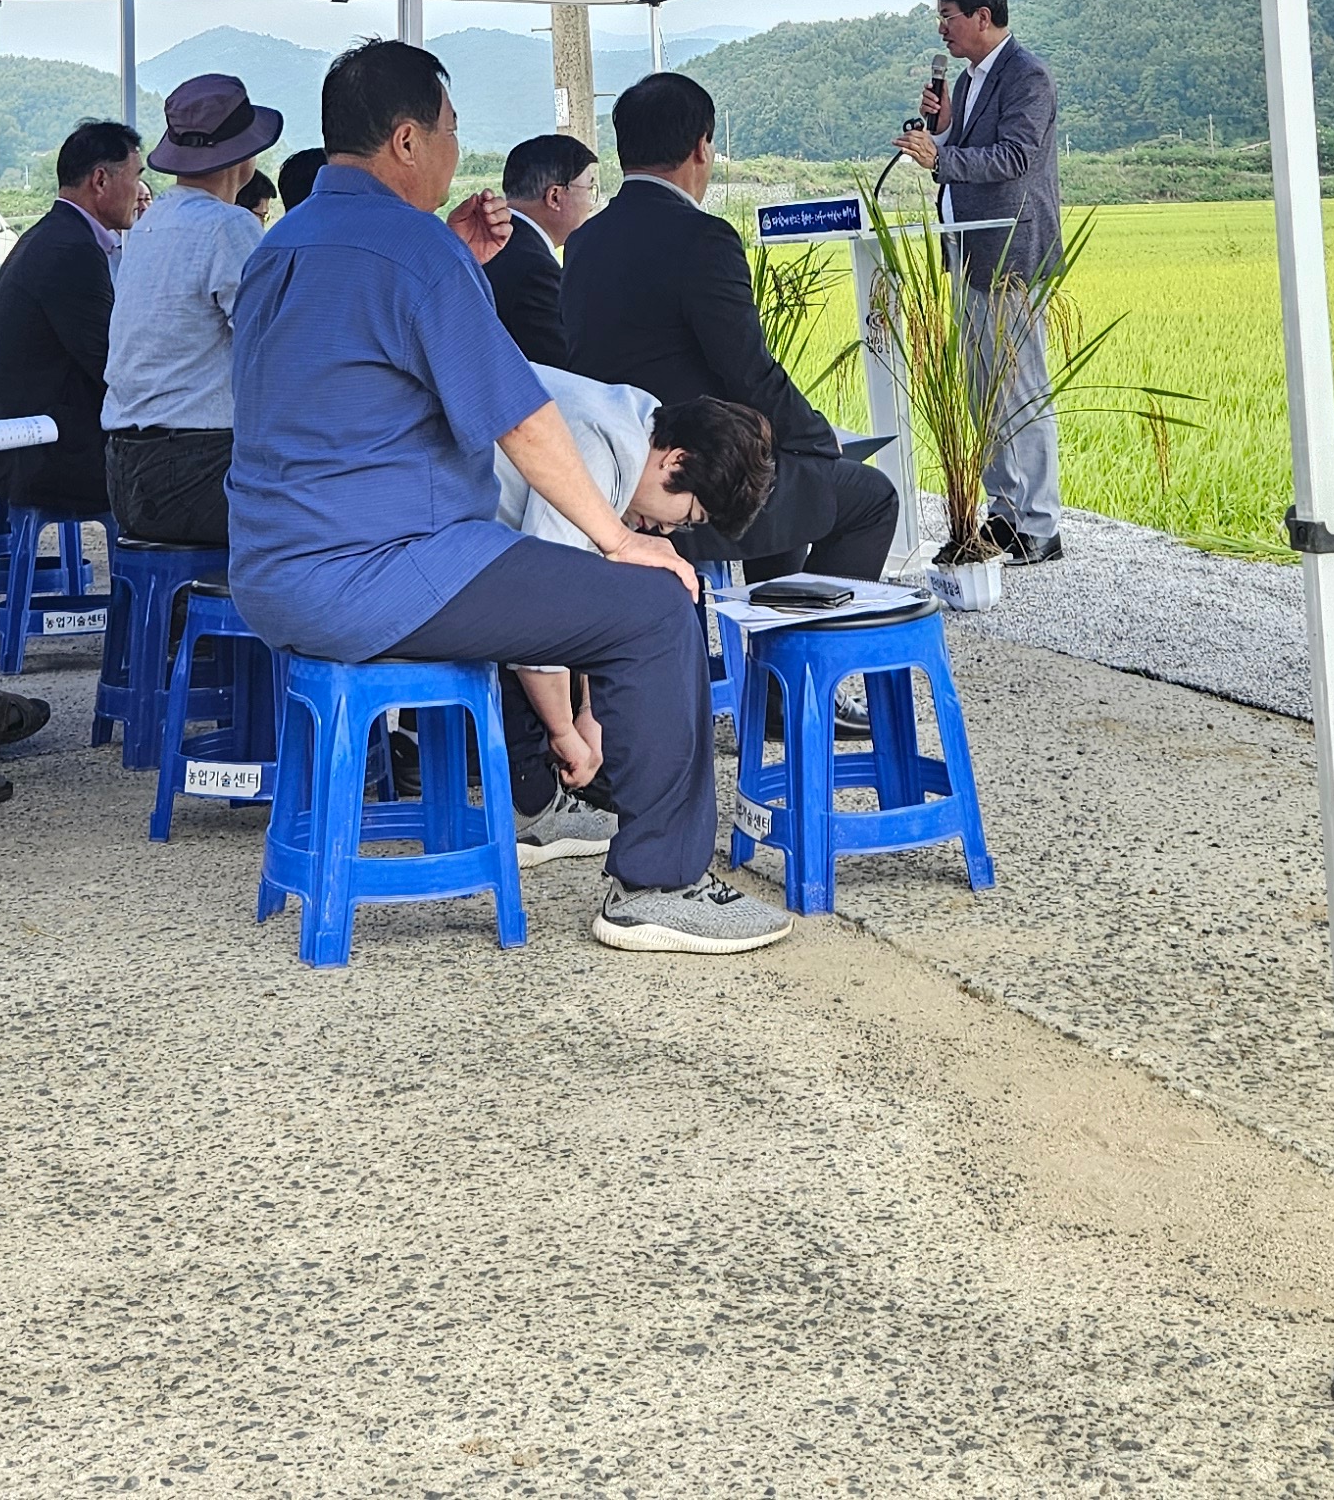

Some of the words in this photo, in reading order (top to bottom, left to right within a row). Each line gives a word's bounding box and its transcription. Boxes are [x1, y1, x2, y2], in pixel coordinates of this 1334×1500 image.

[45, 614, 106, 629] 농업기술센터
[188, 768, 259, 789] 농업기술센터
[736, 802, 770, 832] 업기술센터
